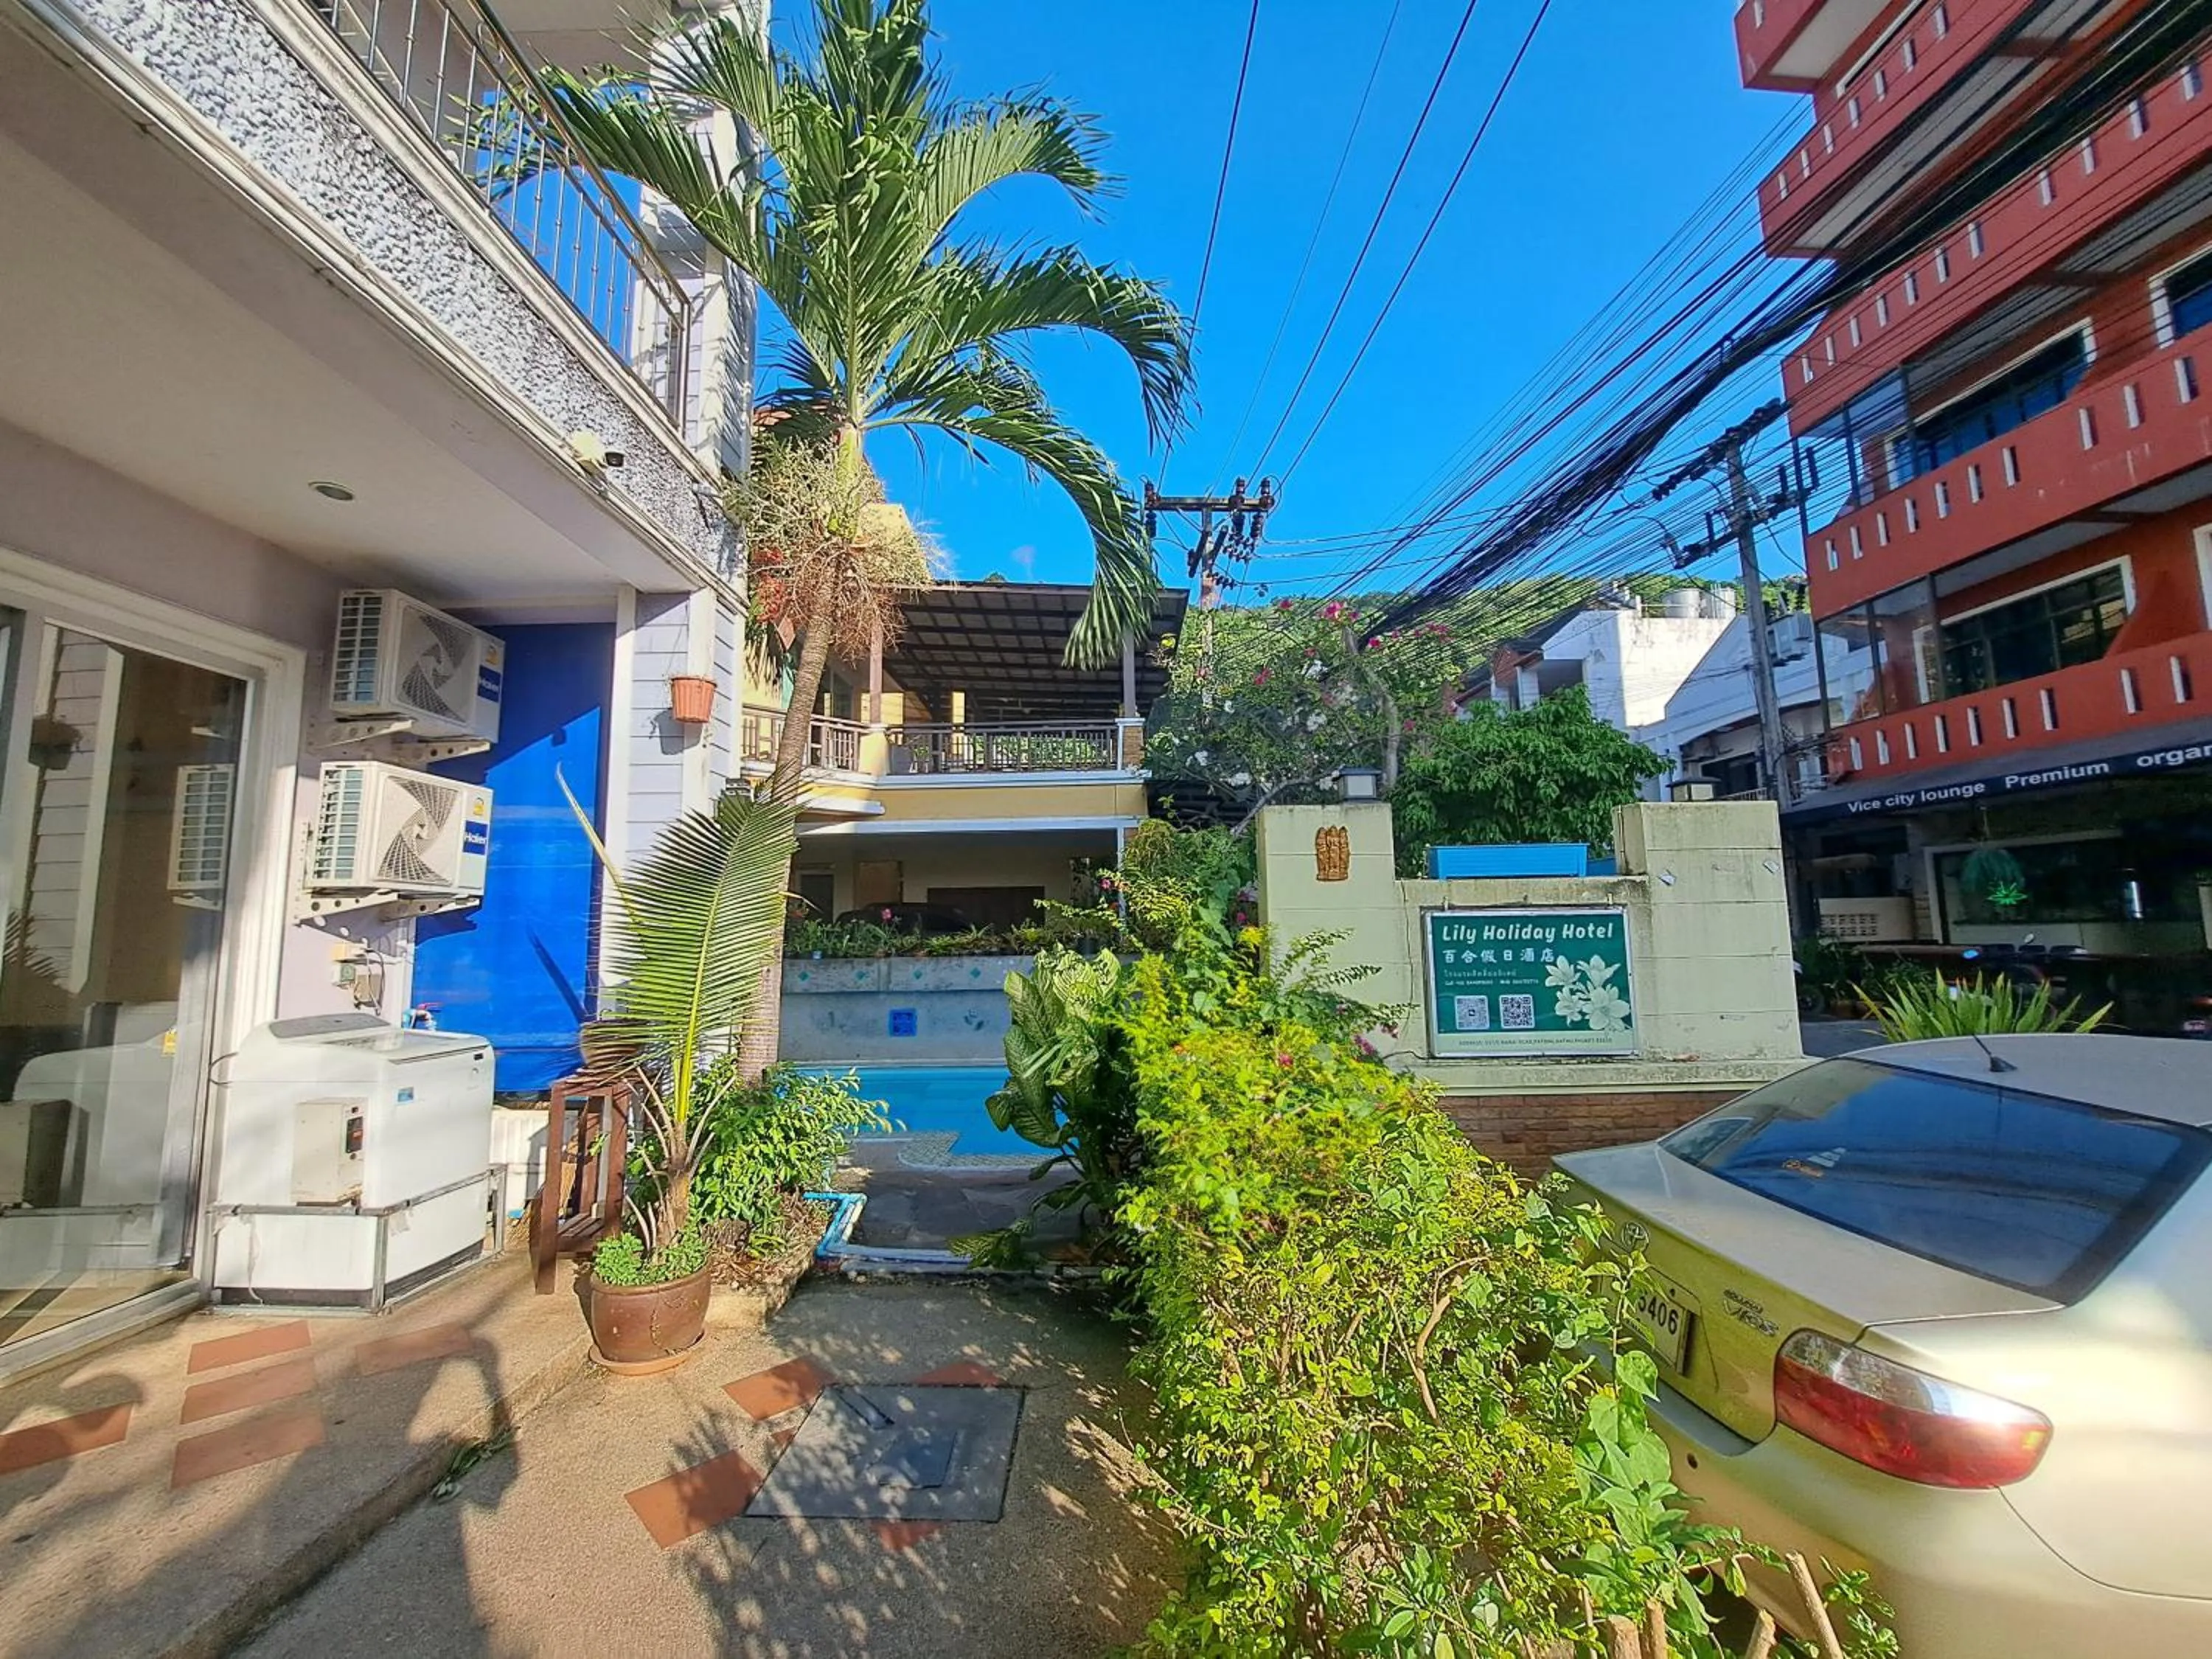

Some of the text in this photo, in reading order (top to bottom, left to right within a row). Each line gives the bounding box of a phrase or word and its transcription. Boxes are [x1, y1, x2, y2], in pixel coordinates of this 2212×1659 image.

[1847, 798, 1882, 814] Vice
[1884, 791, 1916, 811] city
[1920, 779, 1986, 803] lounge
[2005, 761, 2110, 789] Premium
[463, 831, 487, 844] Haier
[1441, 922, 1613, 945] Lily Holiday Hotel
[1442, 947, 1555, 964] 百合假日酒店
